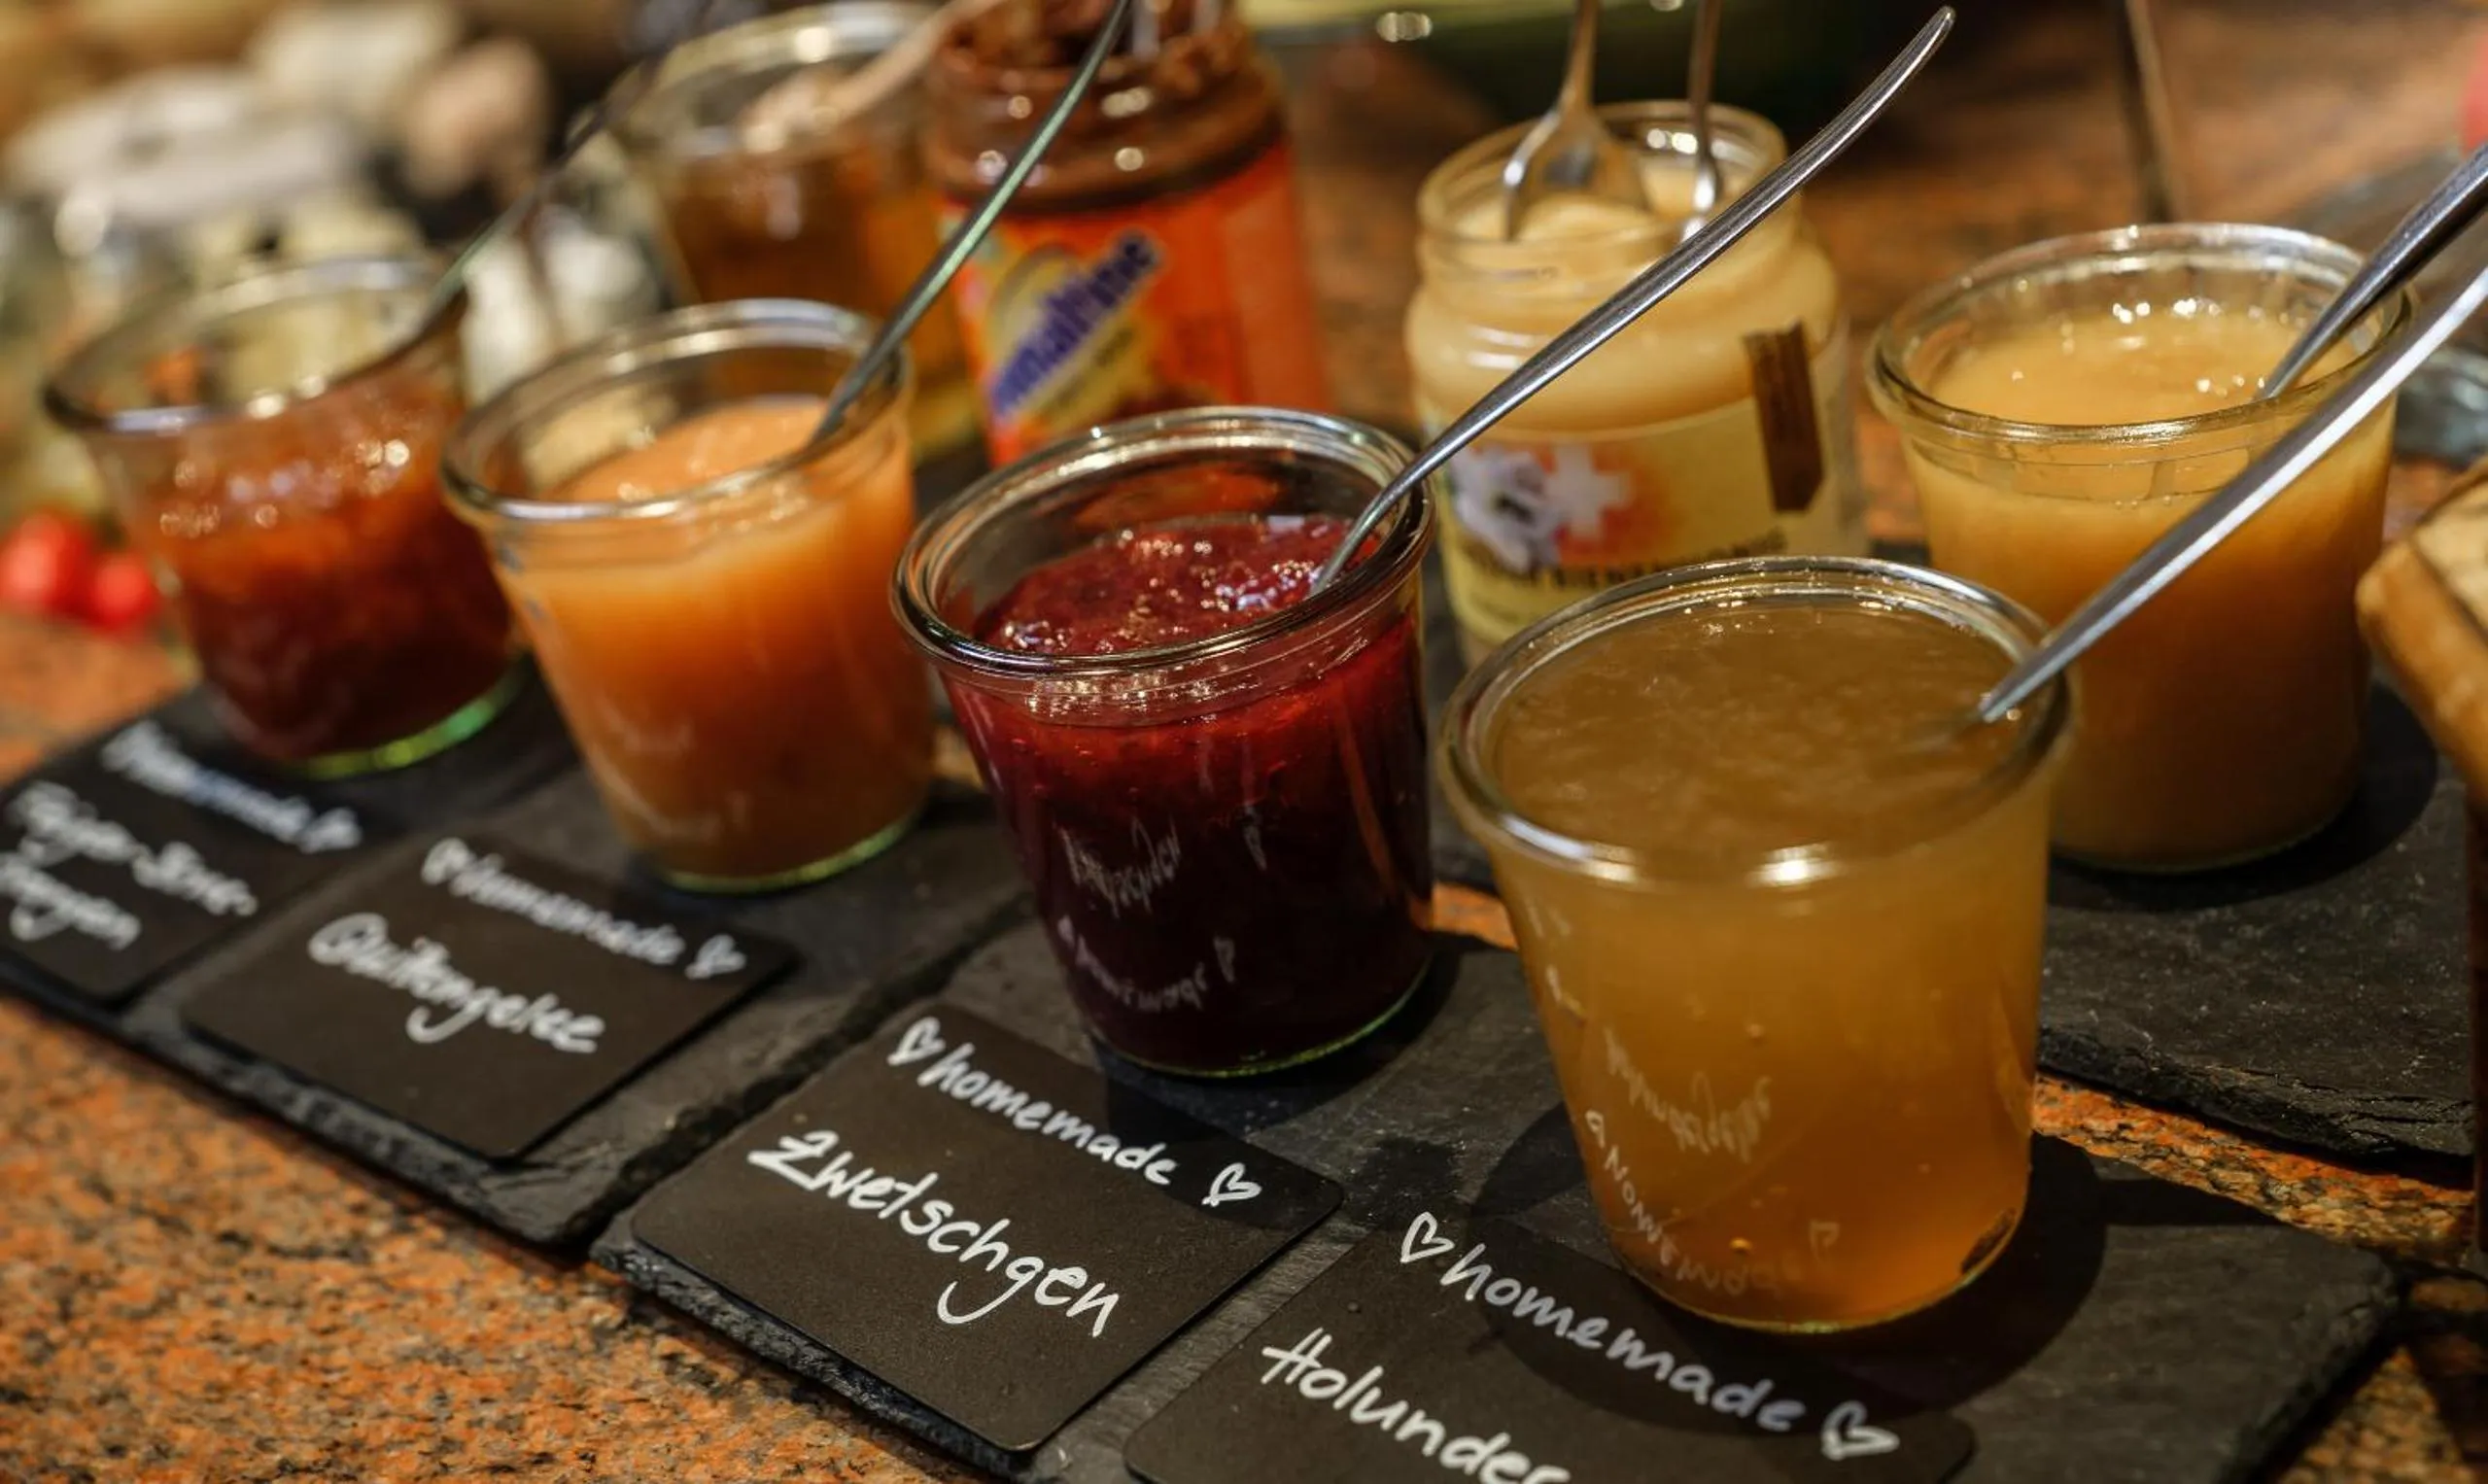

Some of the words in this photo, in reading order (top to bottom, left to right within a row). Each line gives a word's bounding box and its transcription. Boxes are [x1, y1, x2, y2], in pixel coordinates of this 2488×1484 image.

[916, 1043, 1177, 1186] homemade
[746, 1130, 1120, 1338] Zwetschgen
[1438, 1243, 1805, 1432] homemade
